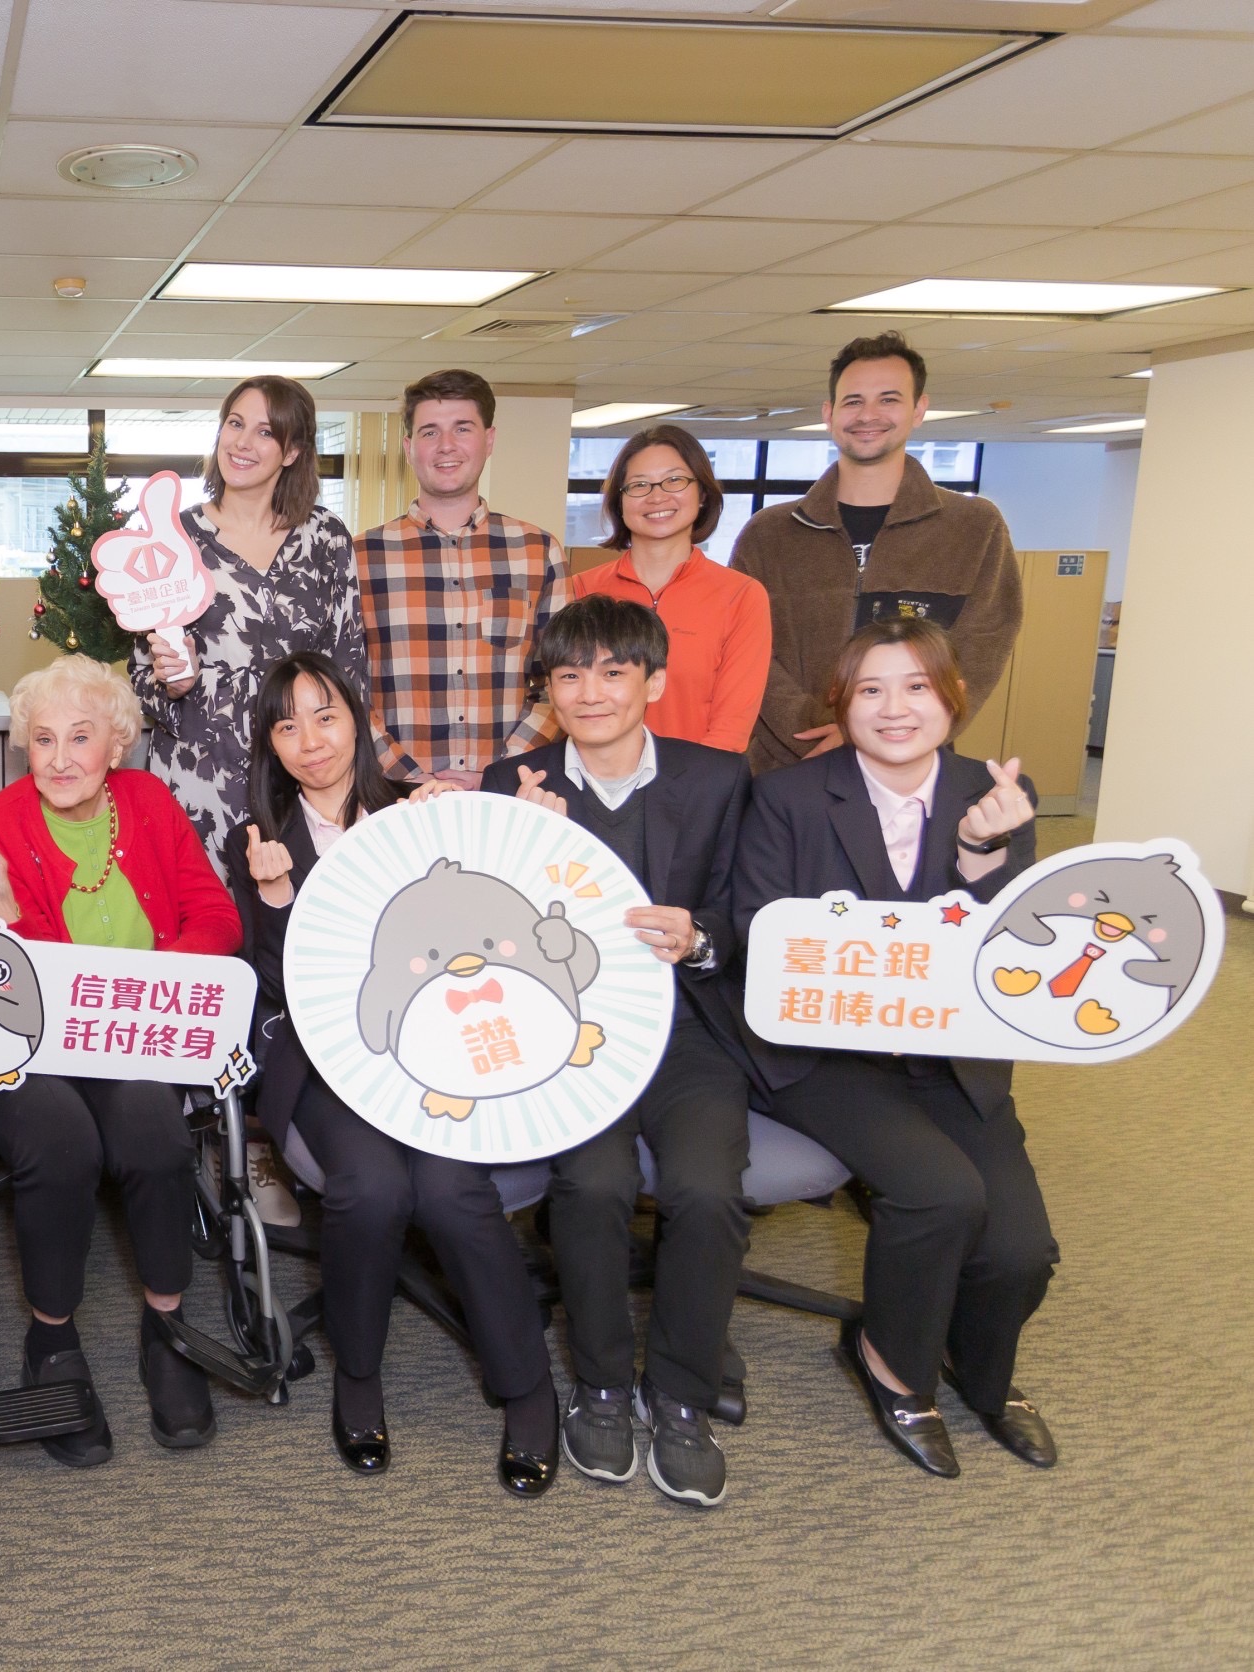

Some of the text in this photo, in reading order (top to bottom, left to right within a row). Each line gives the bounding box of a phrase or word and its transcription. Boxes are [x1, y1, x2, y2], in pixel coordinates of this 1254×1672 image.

[782, 937, 931, 980] 臺企銀
[70, 973, 225, 1017] 信實以諾
[778, 986, 960, 1030] 超棒der
[63, 1017, 217, 1059] 託付終身
[460, 1015, 524, 1076] 讚
